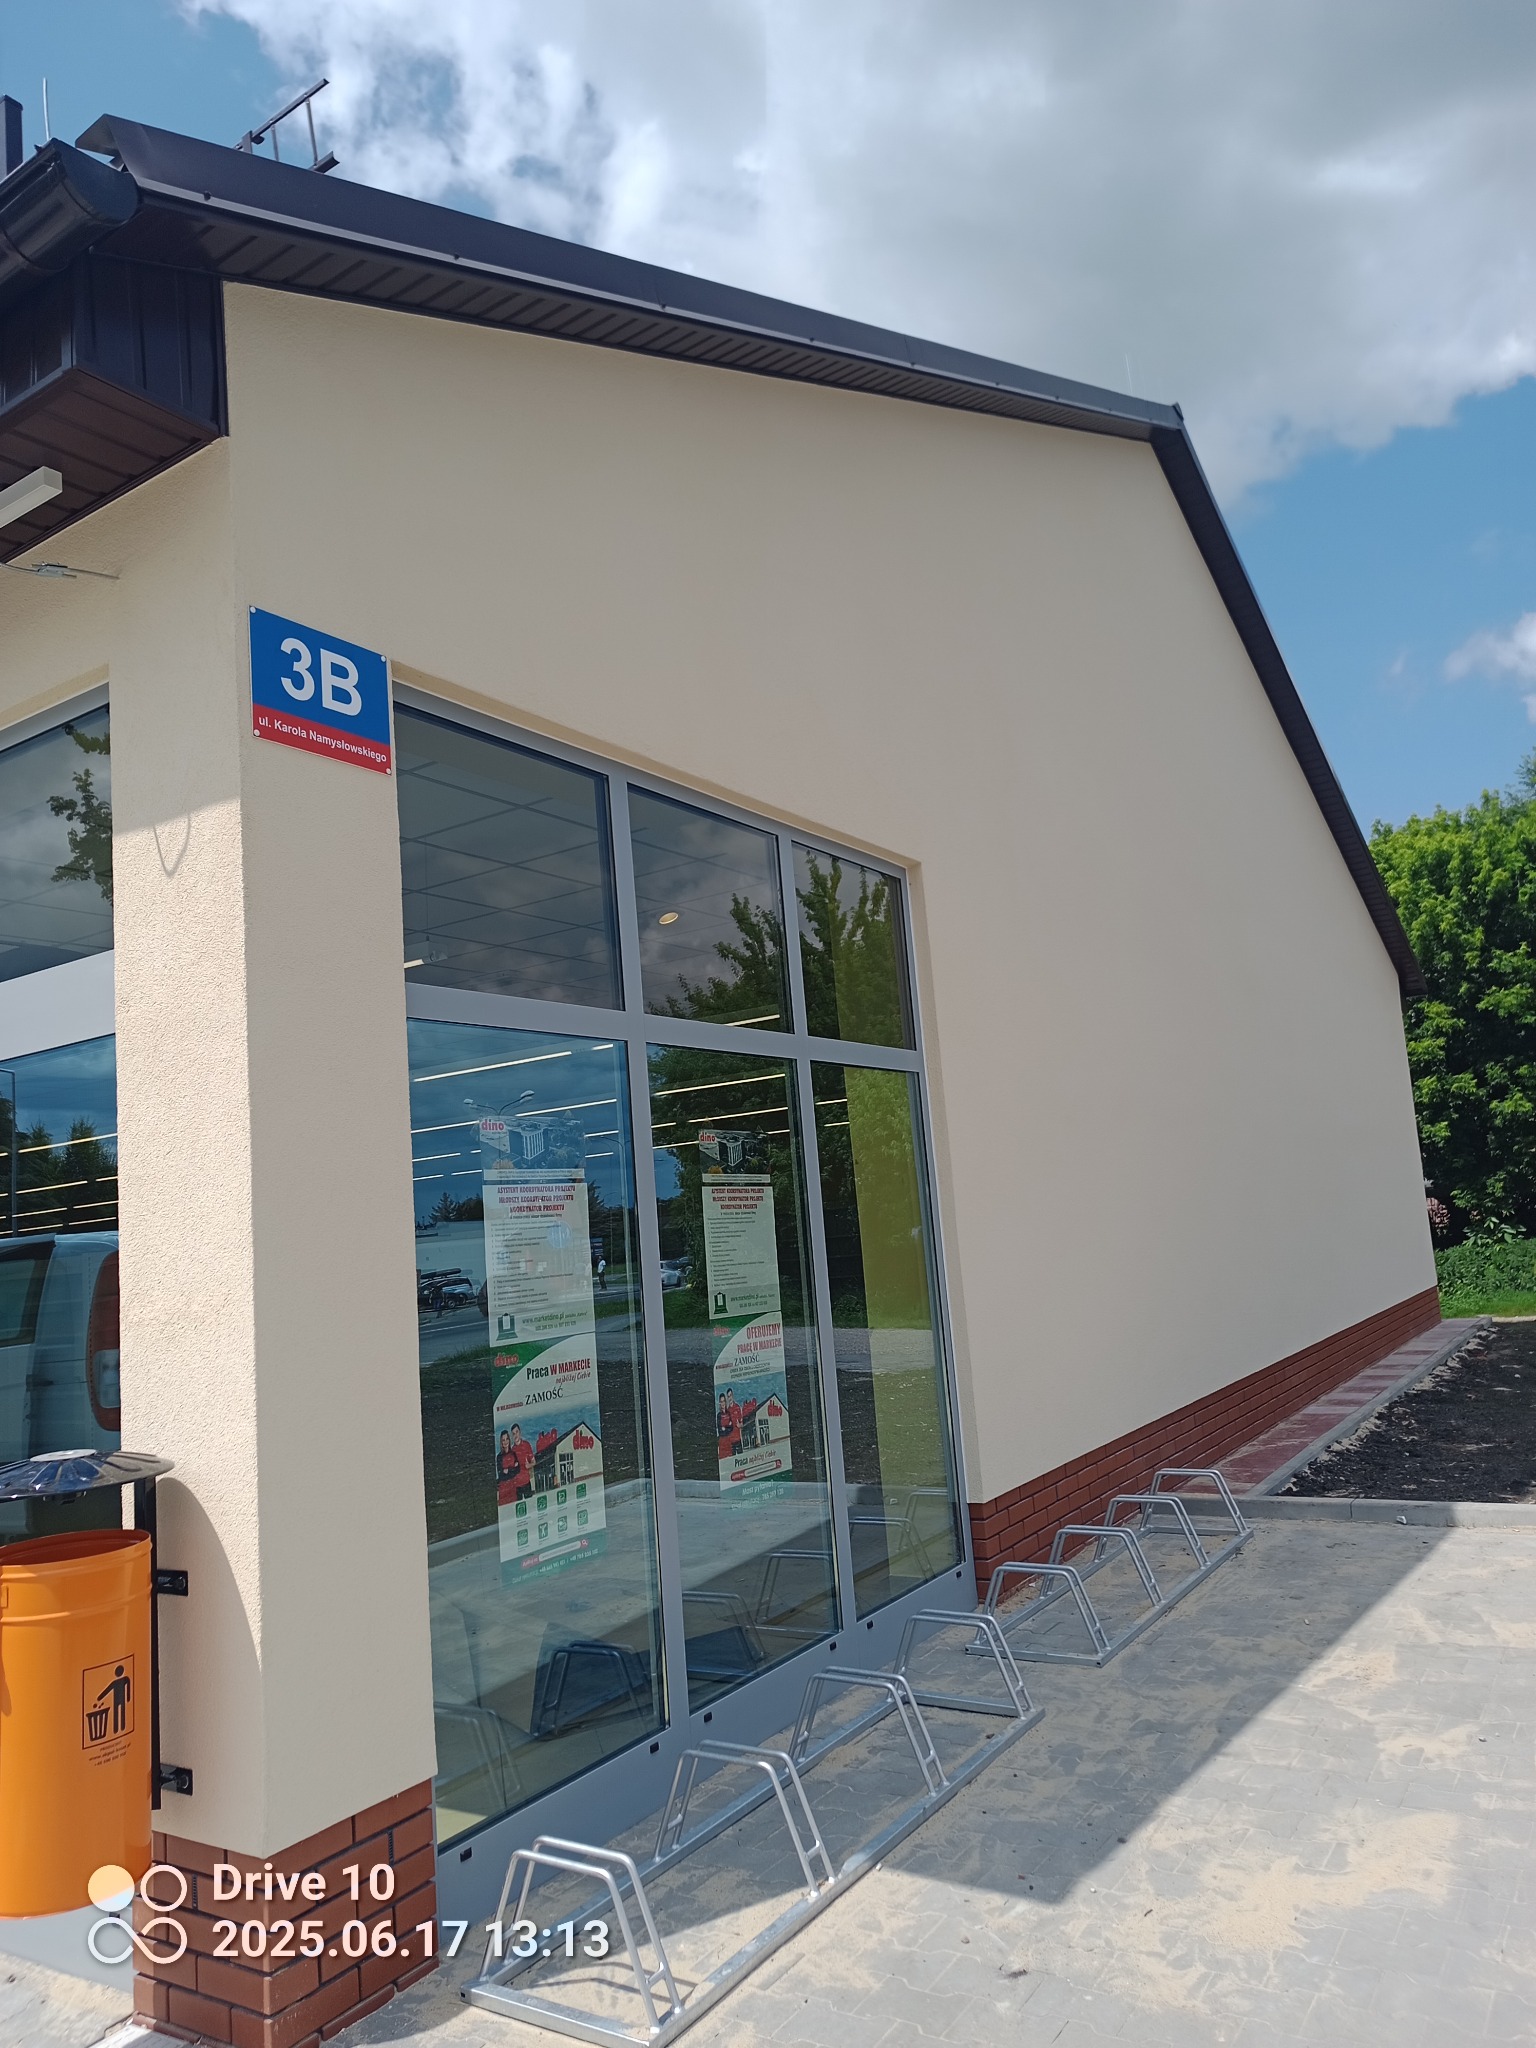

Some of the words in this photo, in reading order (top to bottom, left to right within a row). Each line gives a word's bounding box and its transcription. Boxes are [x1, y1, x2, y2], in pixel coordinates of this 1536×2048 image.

[280, 637, 362, 717] 3B
[259, 717, 271, 728] ul.
[274, 719, 307, 738] Karola
[482, 1120, 504, 1131] dino
[700, 1132, 716, 1142] dino
[747, 1323, 781, 1340] OFERUJEMY
[753, 1342, 759, 1352] W
[494, 1352, 519, 1367] dino
[734, 1353, 760, 1366] ZAMOŚĆ
[526, 1366, 549, 1380] Praca
[550, 1365, 558, 1375] W
[558, 1359, 591, 1373] MARKECIE
[525, 1385, 564, 1405] ZAMOŚĆ
[573, 1429, 594, 1450] dino
[734, 1456, 748, 1467] Praca
